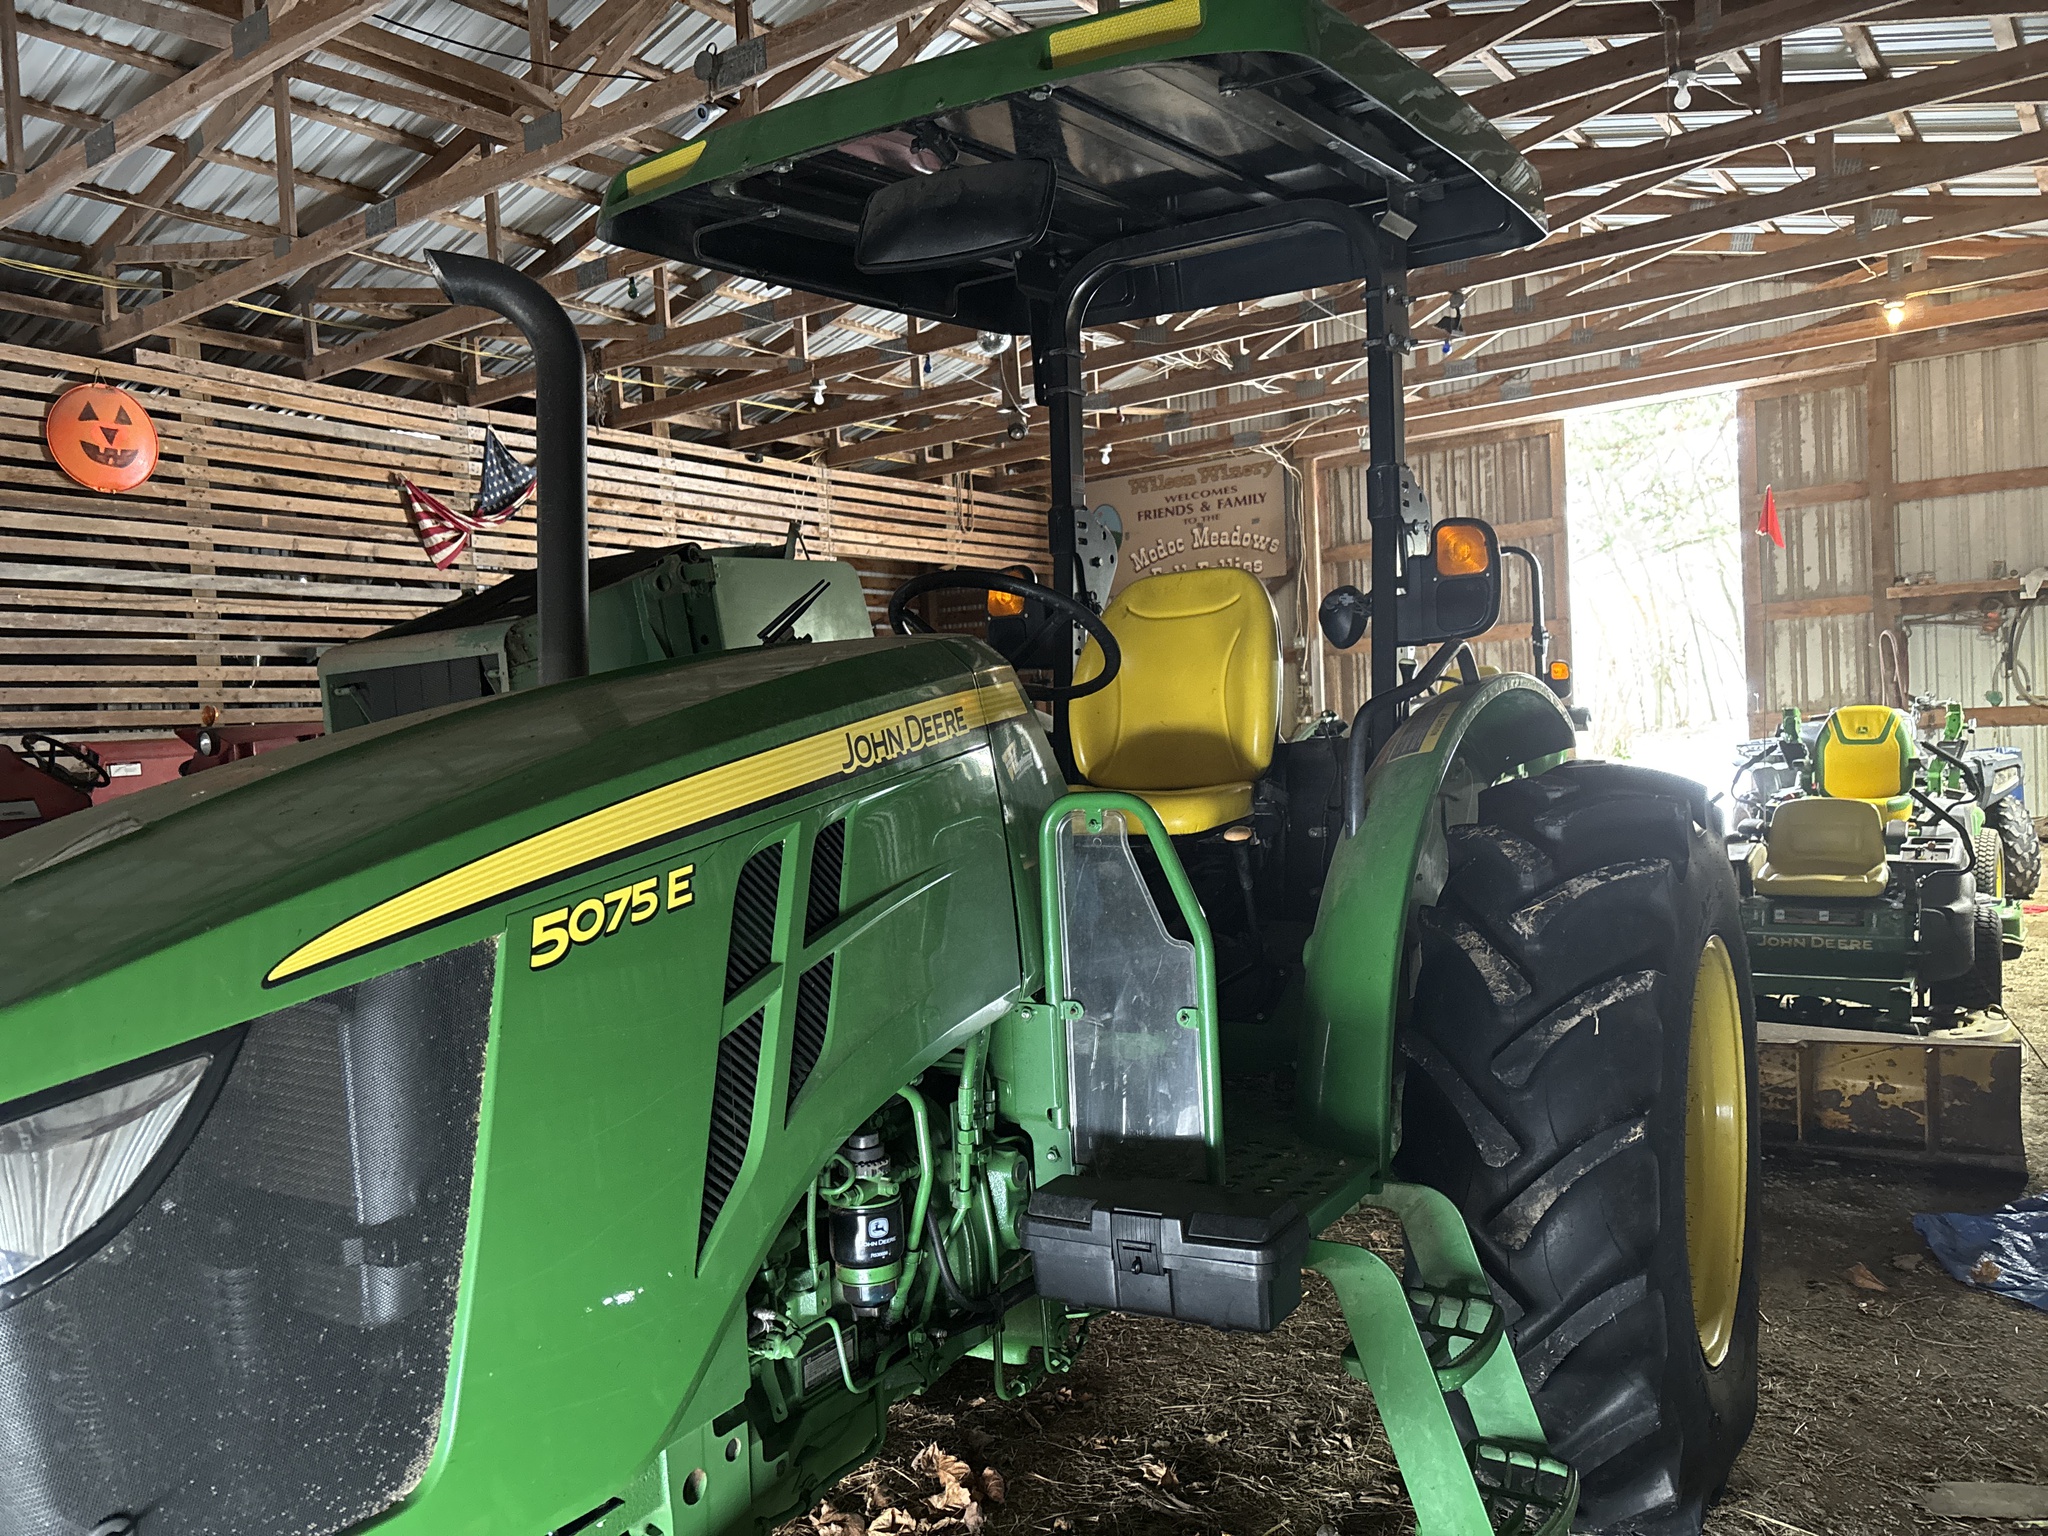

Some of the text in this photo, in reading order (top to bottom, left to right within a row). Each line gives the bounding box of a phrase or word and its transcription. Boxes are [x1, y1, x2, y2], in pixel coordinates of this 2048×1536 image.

[1164, 485, 1238, 503] WELCOMES
[1137, 492, 1267, 522] FRIENDS & FAMILY
[1183, 513, 1220, 526] TO THE
[1129, 525, 1280, 573] Modoc Meadows
[842, 706, 970, 772] JOHN DEERE
[1757, 935, 1874, 951] JOHN DEERE
